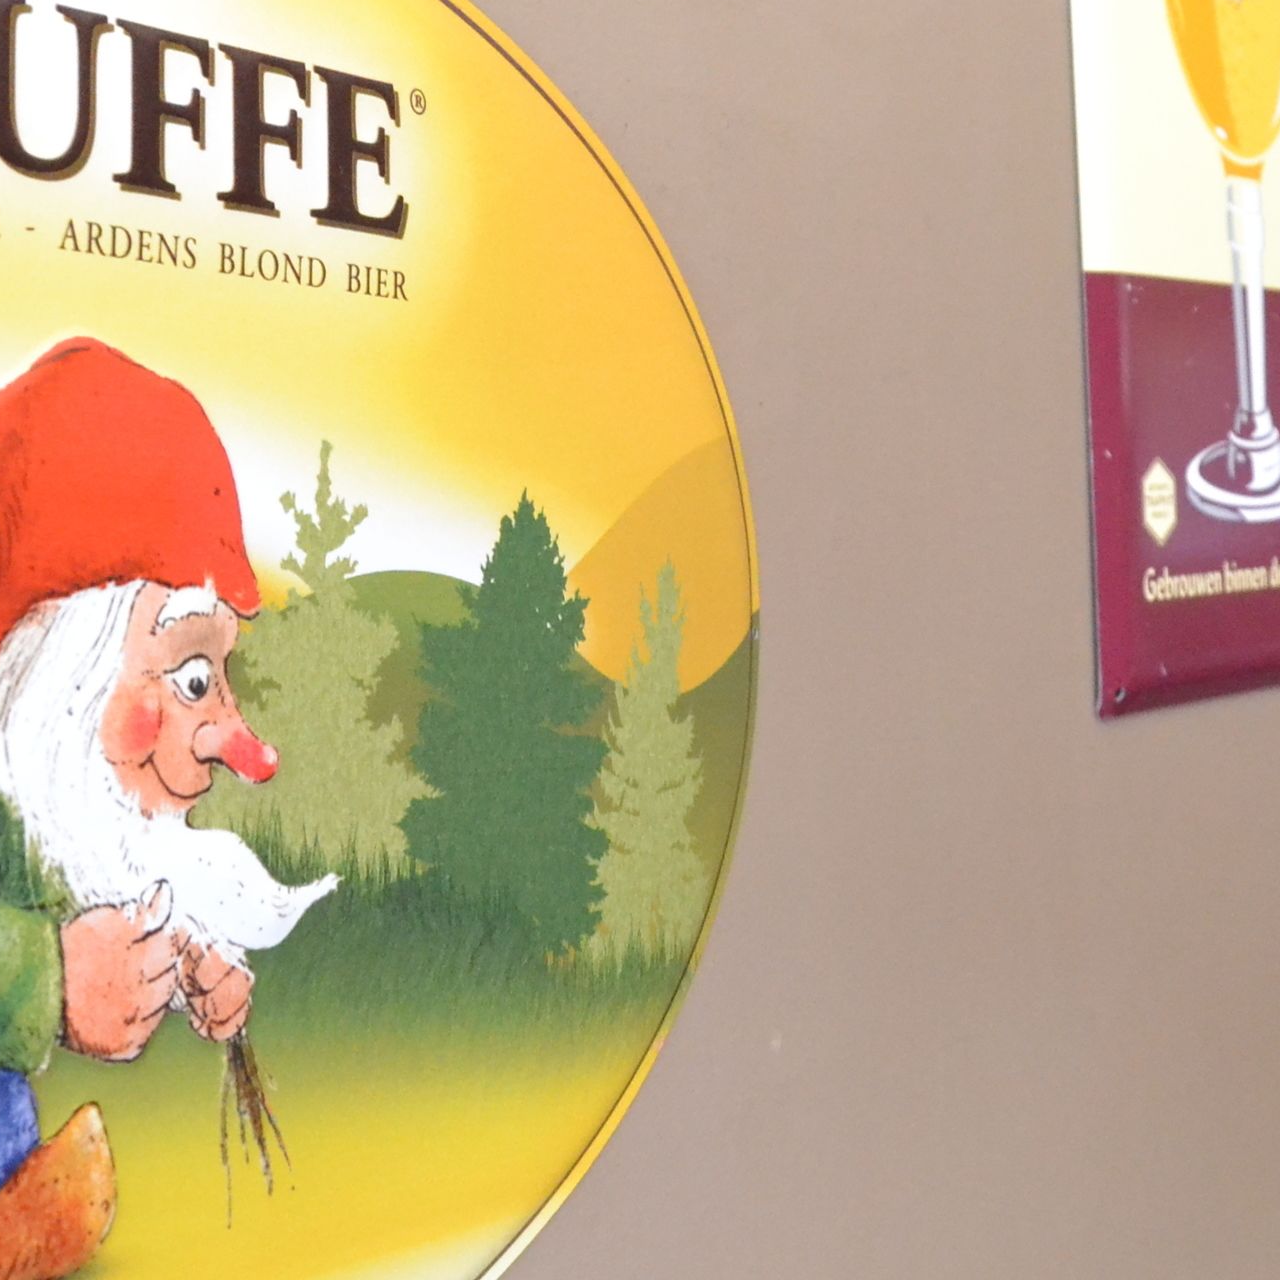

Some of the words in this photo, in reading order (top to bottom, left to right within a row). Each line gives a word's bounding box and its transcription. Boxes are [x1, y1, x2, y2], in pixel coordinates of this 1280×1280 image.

[60, 220, 199, 273] ARDENS
[218, 242, 328, 292] BLOND
[345, 261, 411, 304] BIER
[1142, 566, 1223, 602] Gebrouwen
[1223, 559, 1268, 594] binnen
